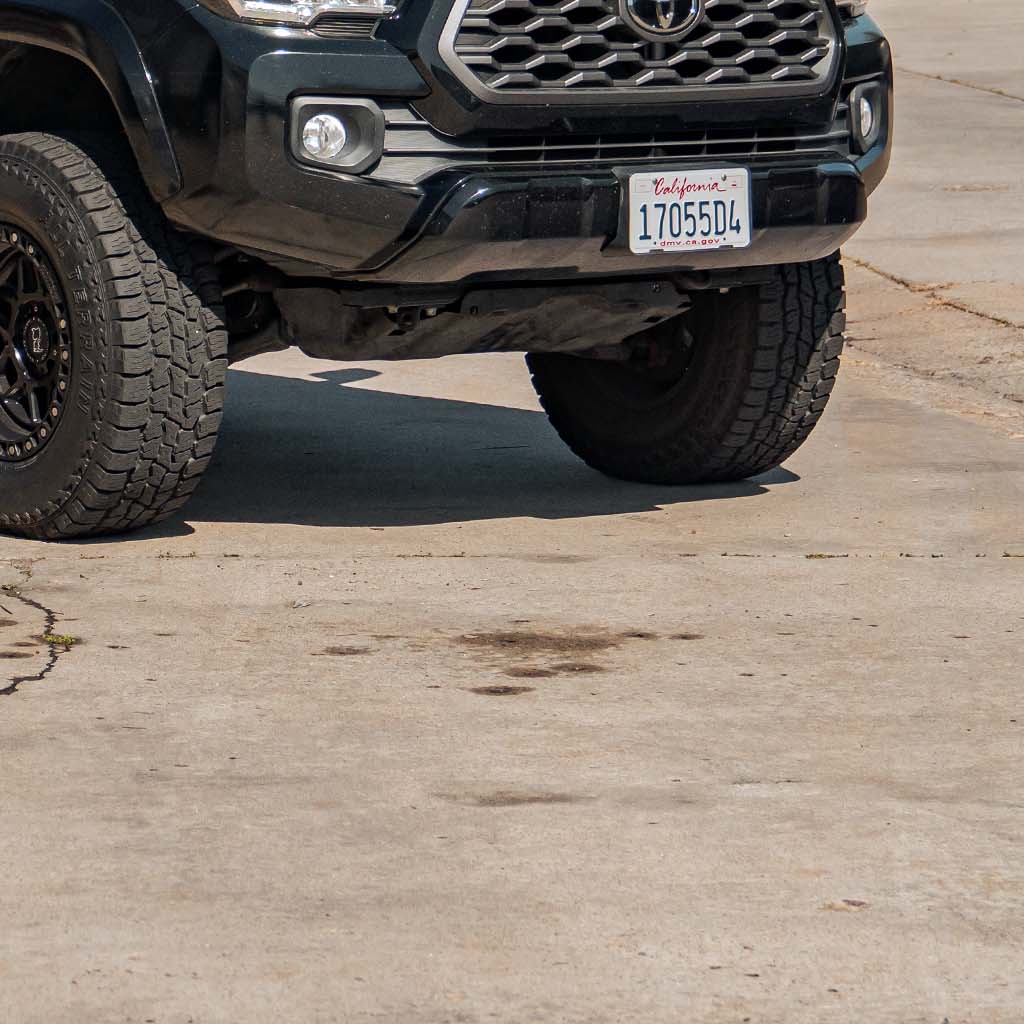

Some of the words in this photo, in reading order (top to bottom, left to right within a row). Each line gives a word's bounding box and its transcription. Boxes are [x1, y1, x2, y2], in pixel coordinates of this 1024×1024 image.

[654, 177, 726, 200] California
[638, 199, 742, 241] 17055D4
[660, 238, 720, 247] dmv.ca.gov
[69, 265, 95, 414] TERRAIN
